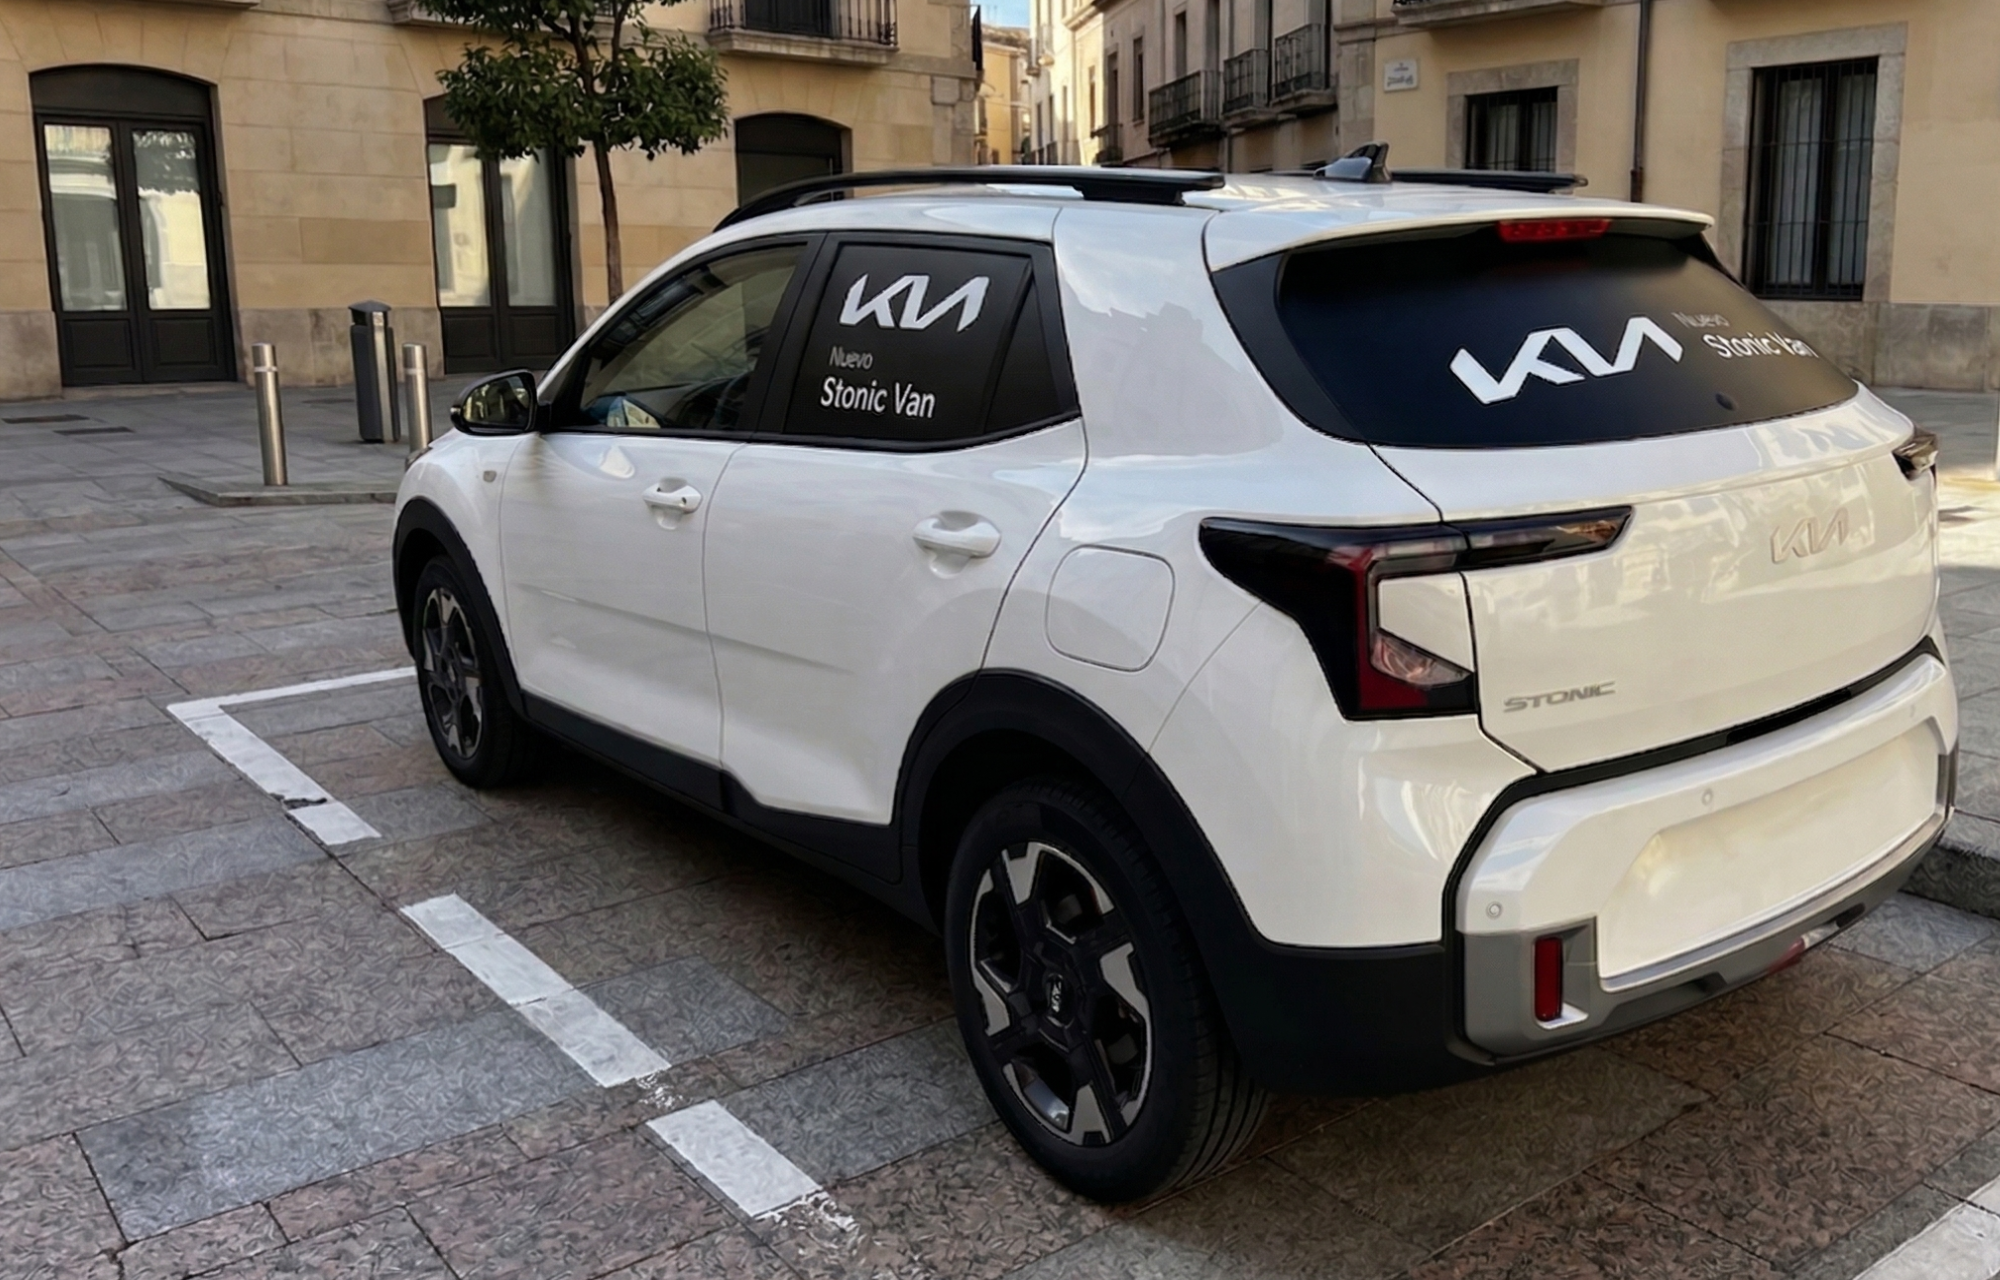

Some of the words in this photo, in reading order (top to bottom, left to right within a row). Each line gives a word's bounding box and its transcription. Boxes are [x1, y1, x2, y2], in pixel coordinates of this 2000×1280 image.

[839, 273, 990, 332] KIA
[829, 346, 873, 370] Nuevo
[1449, 316, 1683, 405] KIA
[1702, 333, 1782, 358] Stonic
[1765, 331, 1819, 358] Van
[820, 376, 888, 412] Stonic
[894, 382, 936, 418] Van
[1770, 507, 1849, 564] KIA
[1503, 681, 1616, 713] STONIC
